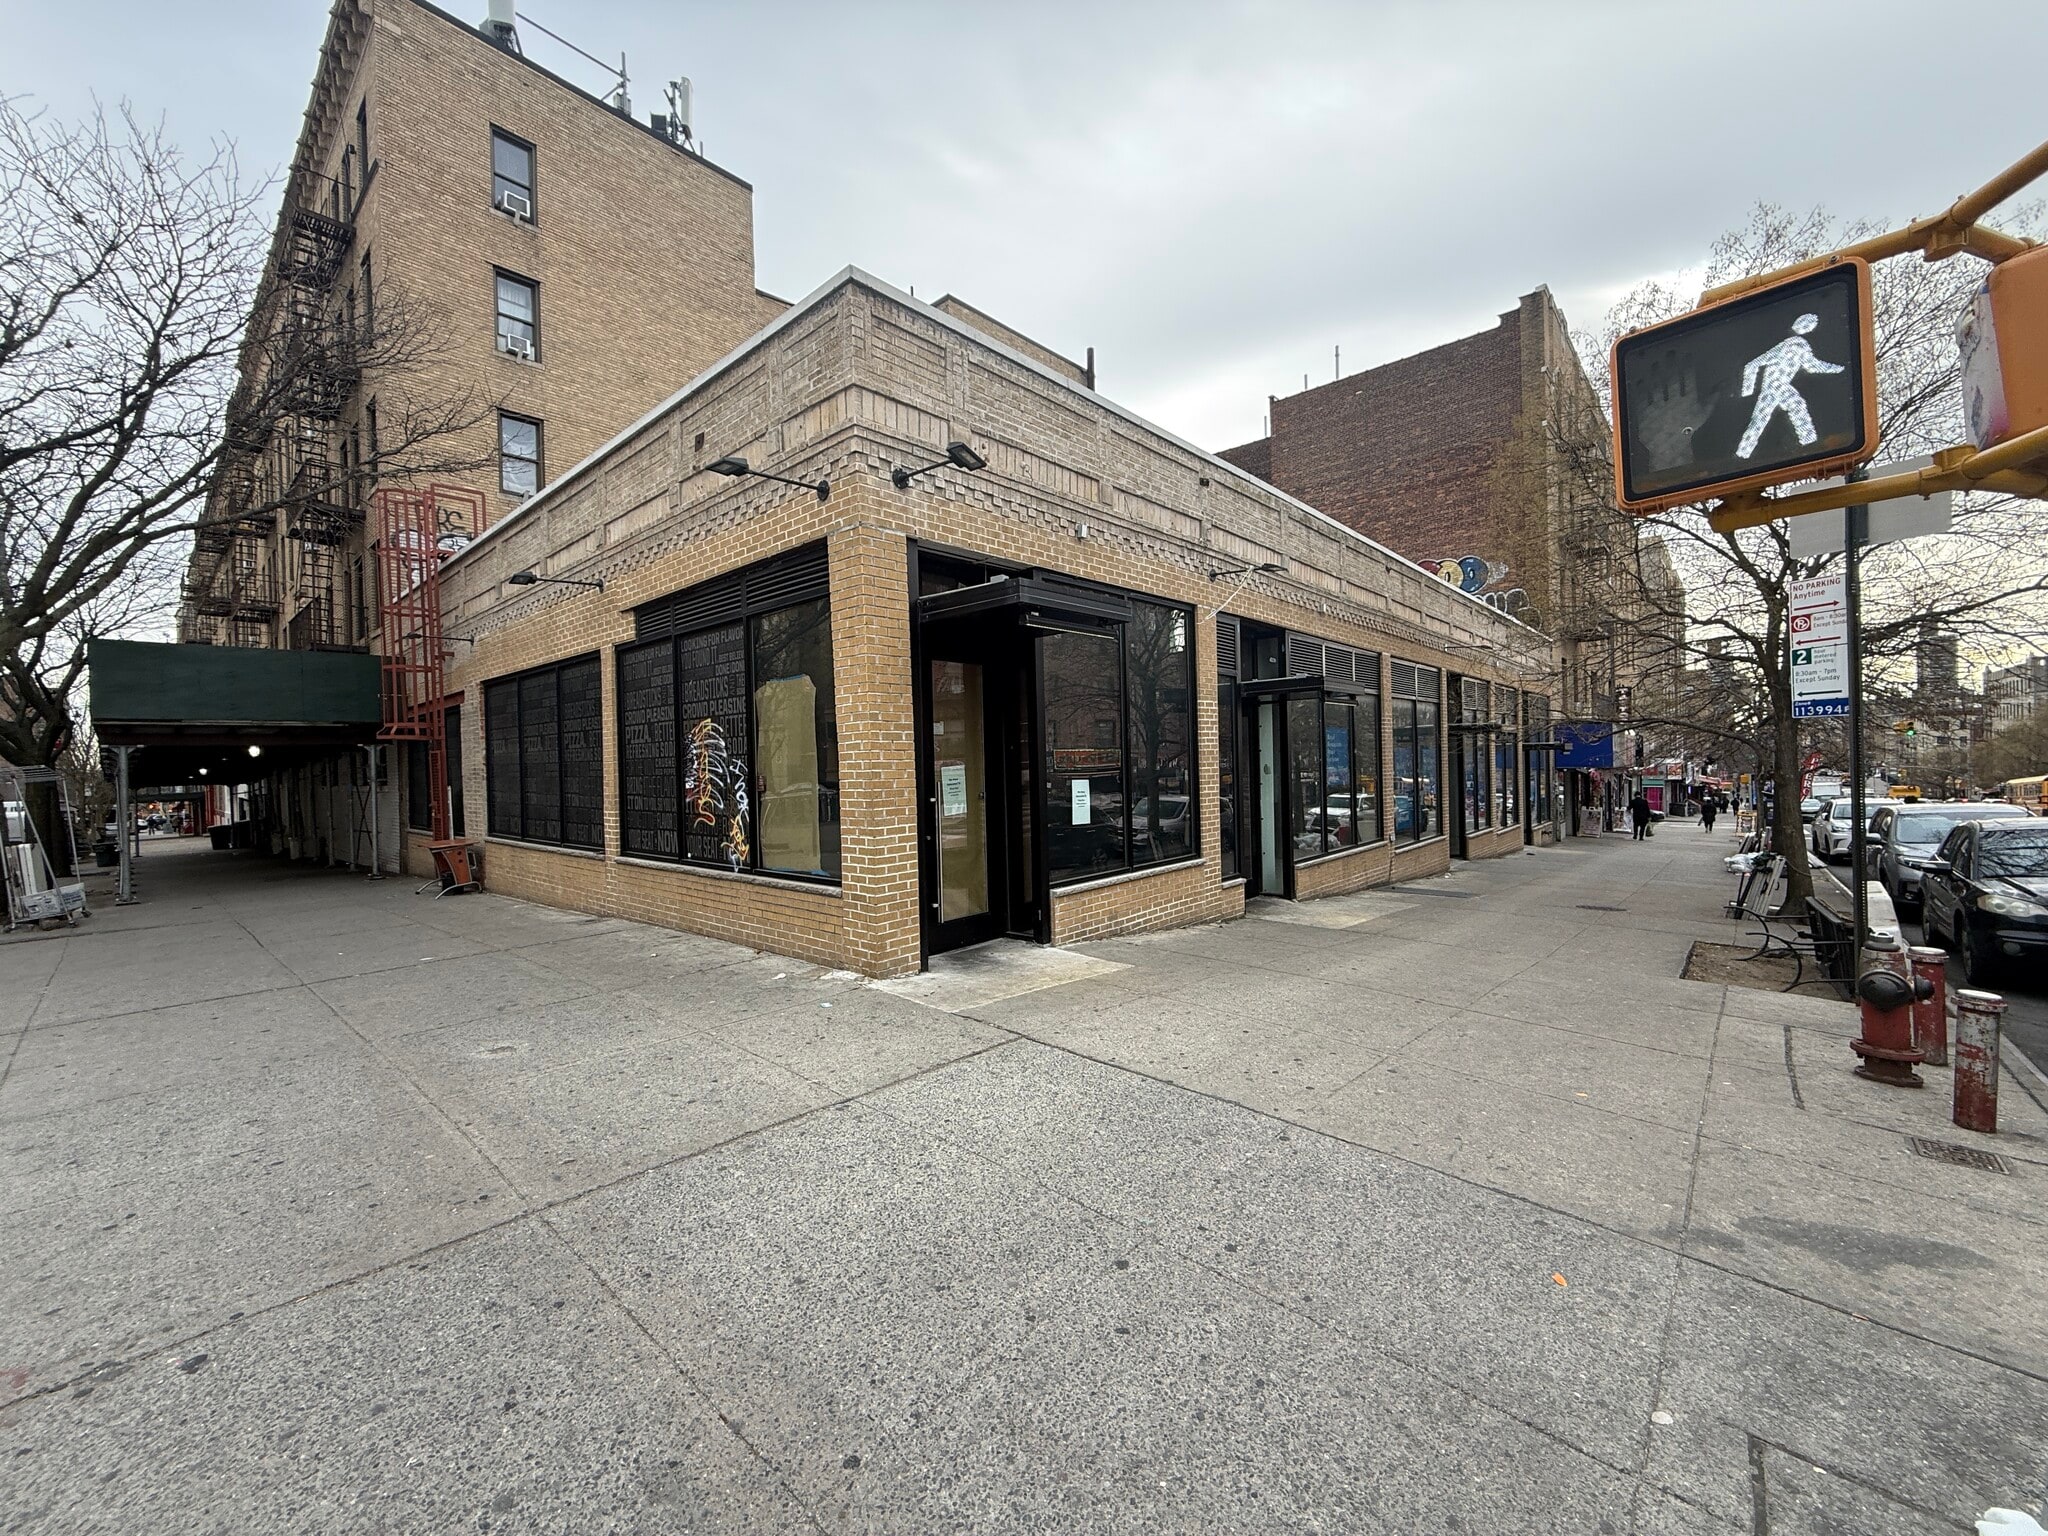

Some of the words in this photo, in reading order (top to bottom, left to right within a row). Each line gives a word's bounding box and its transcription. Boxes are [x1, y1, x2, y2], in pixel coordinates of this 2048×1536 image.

[1793, 584, 1804, 592] NO
[1806, 577, 1841, 590] PARKING
[1793, 589, 1826, 600] Anytime
[708, 632, 720, 646] FOR
[1797, 650, 1807, 664] 2
[684, 676, 728, 702] BREADSTICKS
[682, 701, 708, 719] CROWD
[1794, 705, 1842, 716] 113994
[703, 836, 718, 859] SEAT
